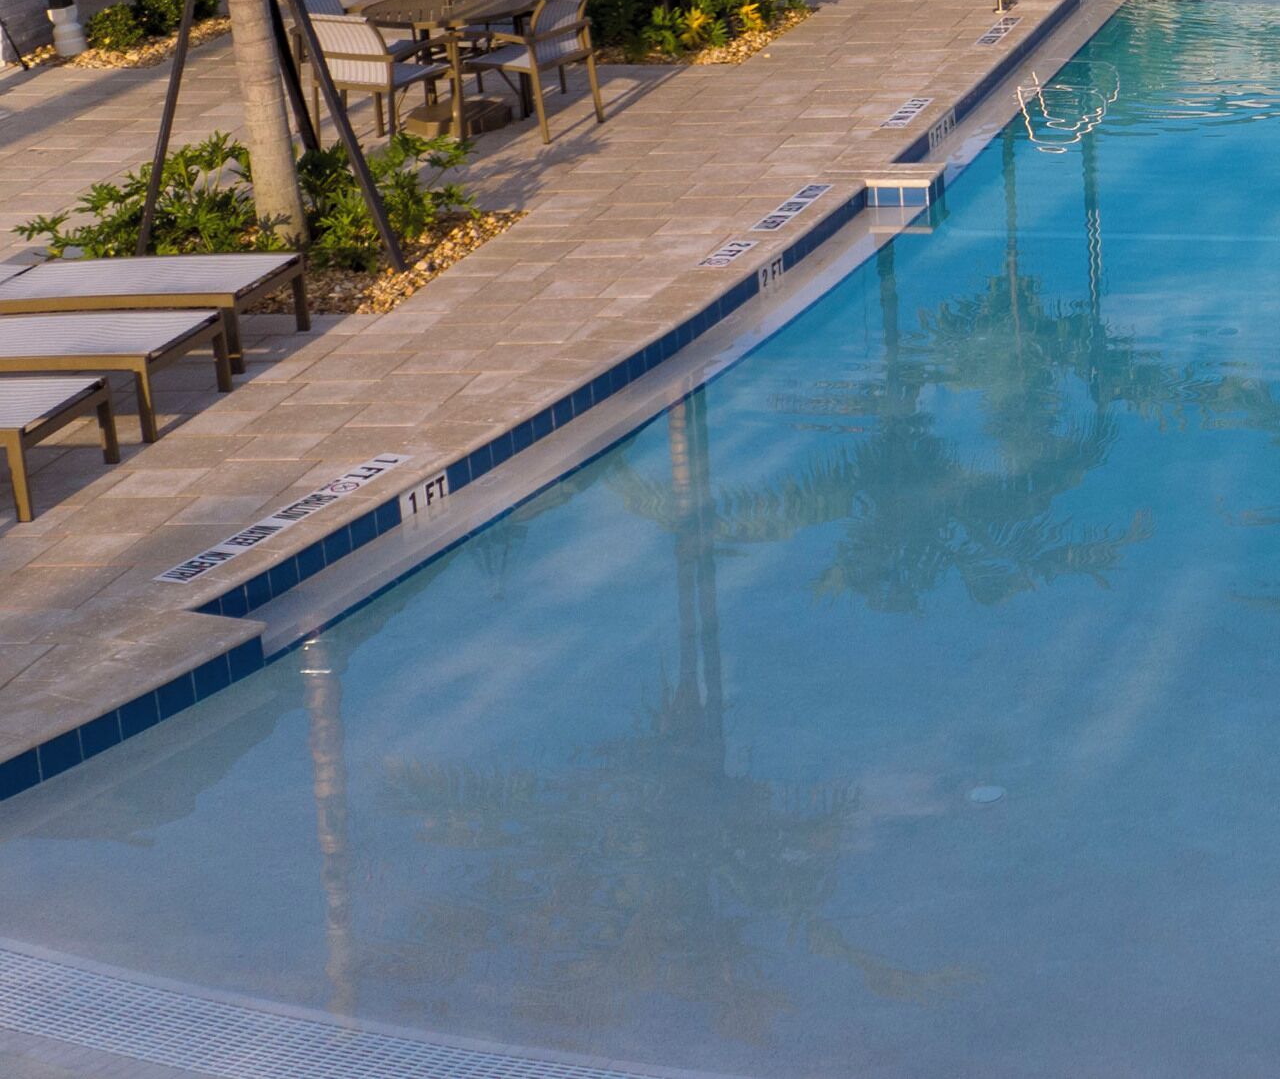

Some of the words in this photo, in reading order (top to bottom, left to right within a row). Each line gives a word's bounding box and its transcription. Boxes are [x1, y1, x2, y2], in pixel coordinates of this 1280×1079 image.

[762, 268, 768, 287] 2
[771, 257, 782, 280] FT
[409, 491, 418, 514] 1
[425, 475, 446, 506] FT
[272, 493, 338, 522] SHALLOW
[224, 525, 284, 547] WATER
[198, 551, 236, 561] NO
[162, 560, 217, 581] ENTRY
